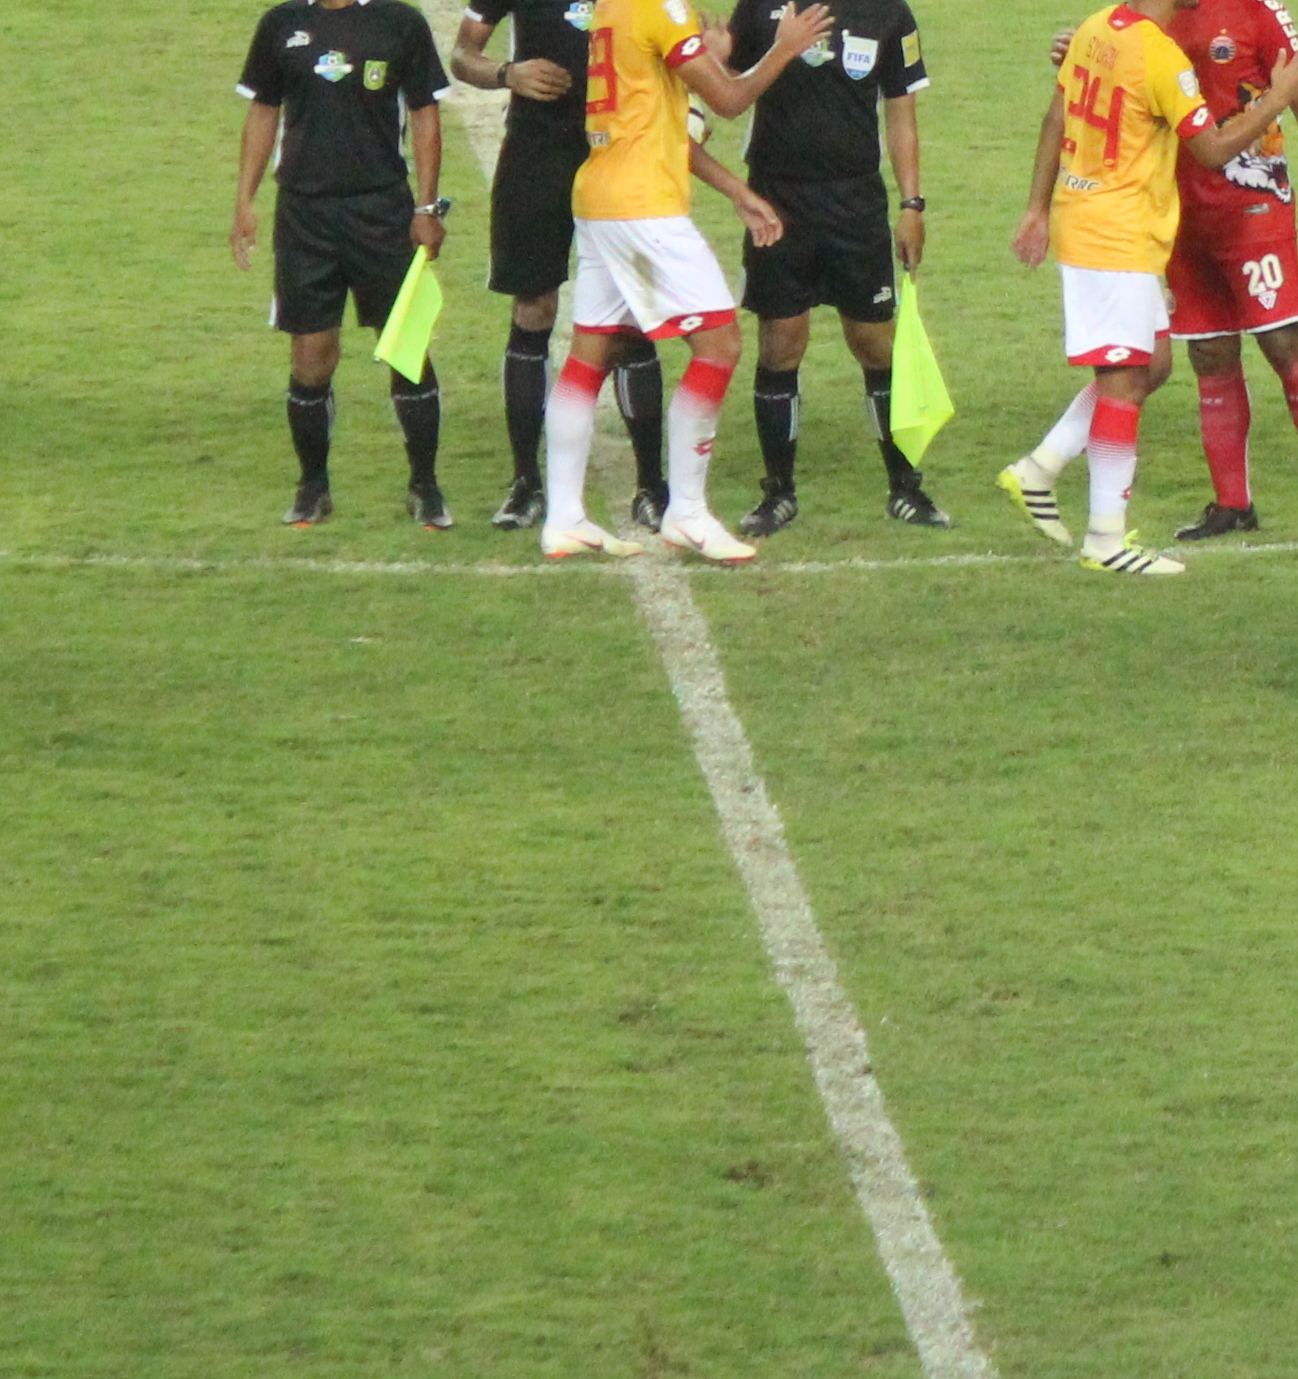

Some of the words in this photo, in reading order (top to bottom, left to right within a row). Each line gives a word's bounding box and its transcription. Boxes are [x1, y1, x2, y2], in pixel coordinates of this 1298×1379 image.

[846, 51, 871, 65] FIFA
[1061, 63, 1125, 170] 24
[1242, 253, 1285, 296] 20
